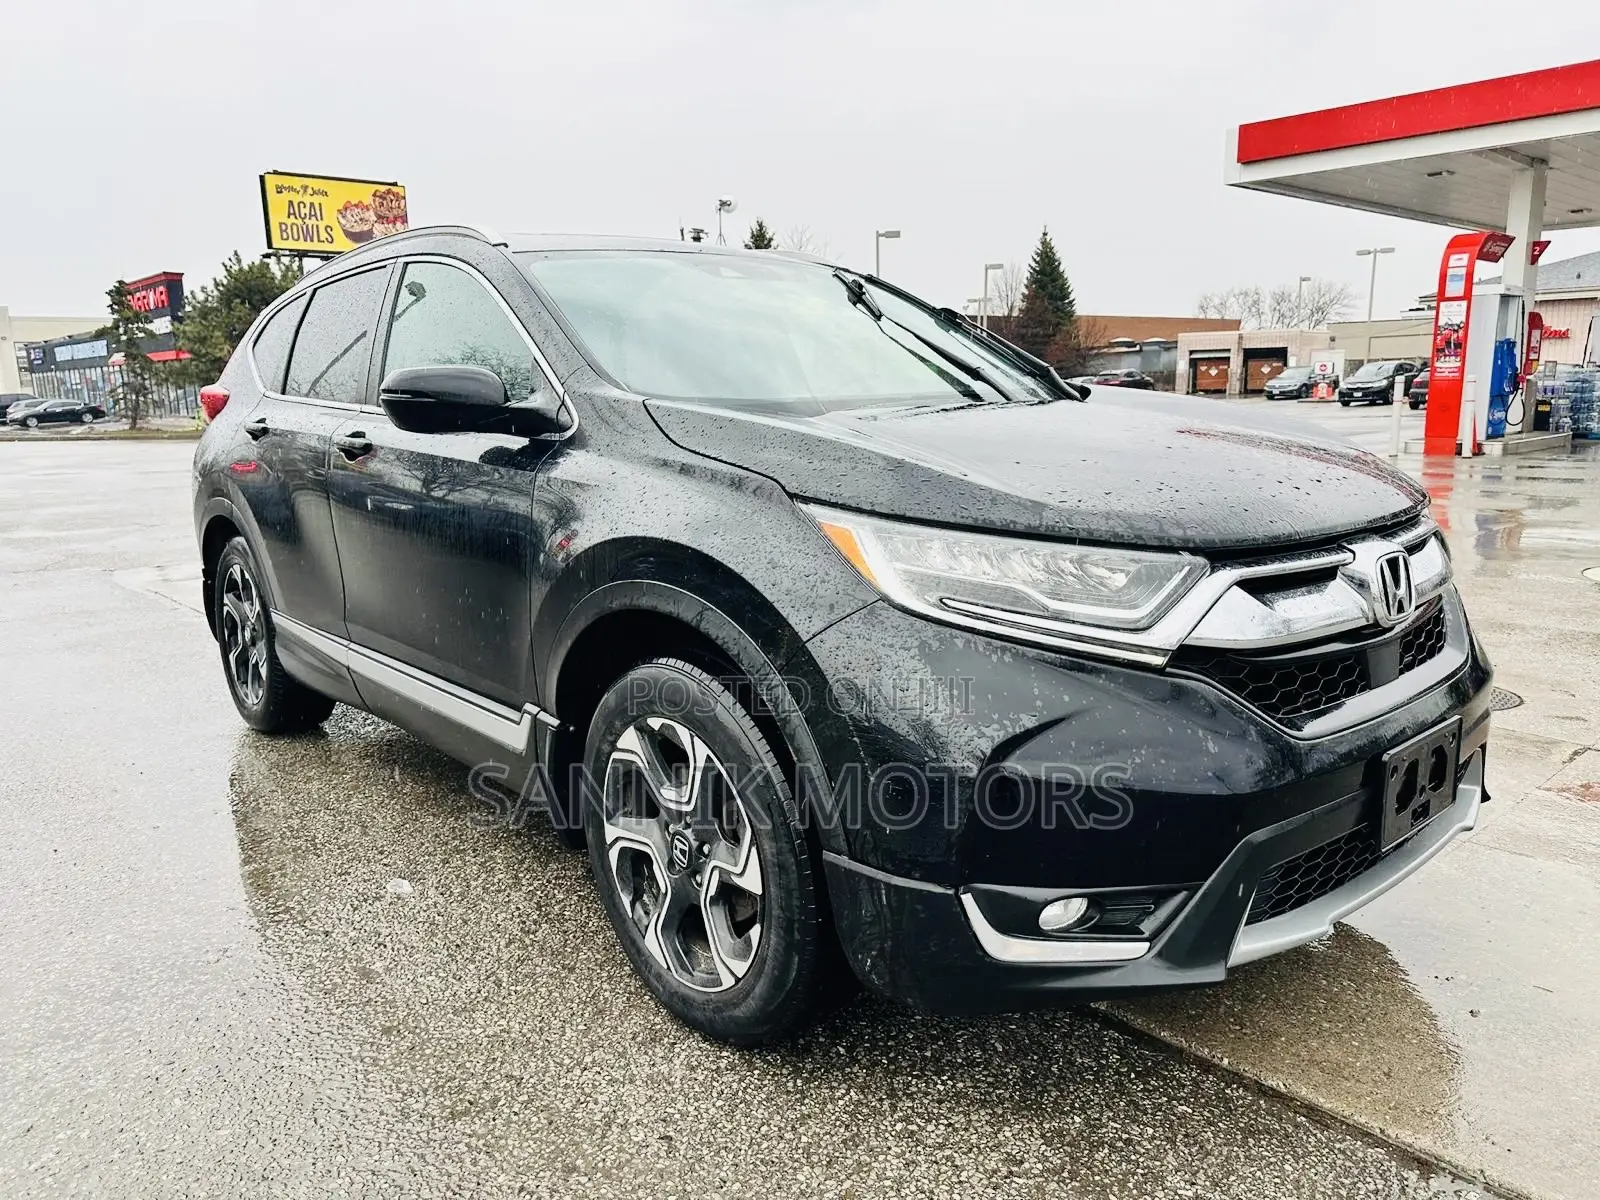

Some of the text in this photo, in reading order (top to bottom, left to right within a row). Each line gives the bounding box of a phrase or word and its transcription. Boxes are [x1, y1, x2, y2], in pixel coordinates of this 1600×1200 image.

[287, 200, 324, 224] AÇAI
[279, 221, 335, 244] BOWLS
[1533, 247, 1540, 255] 2
